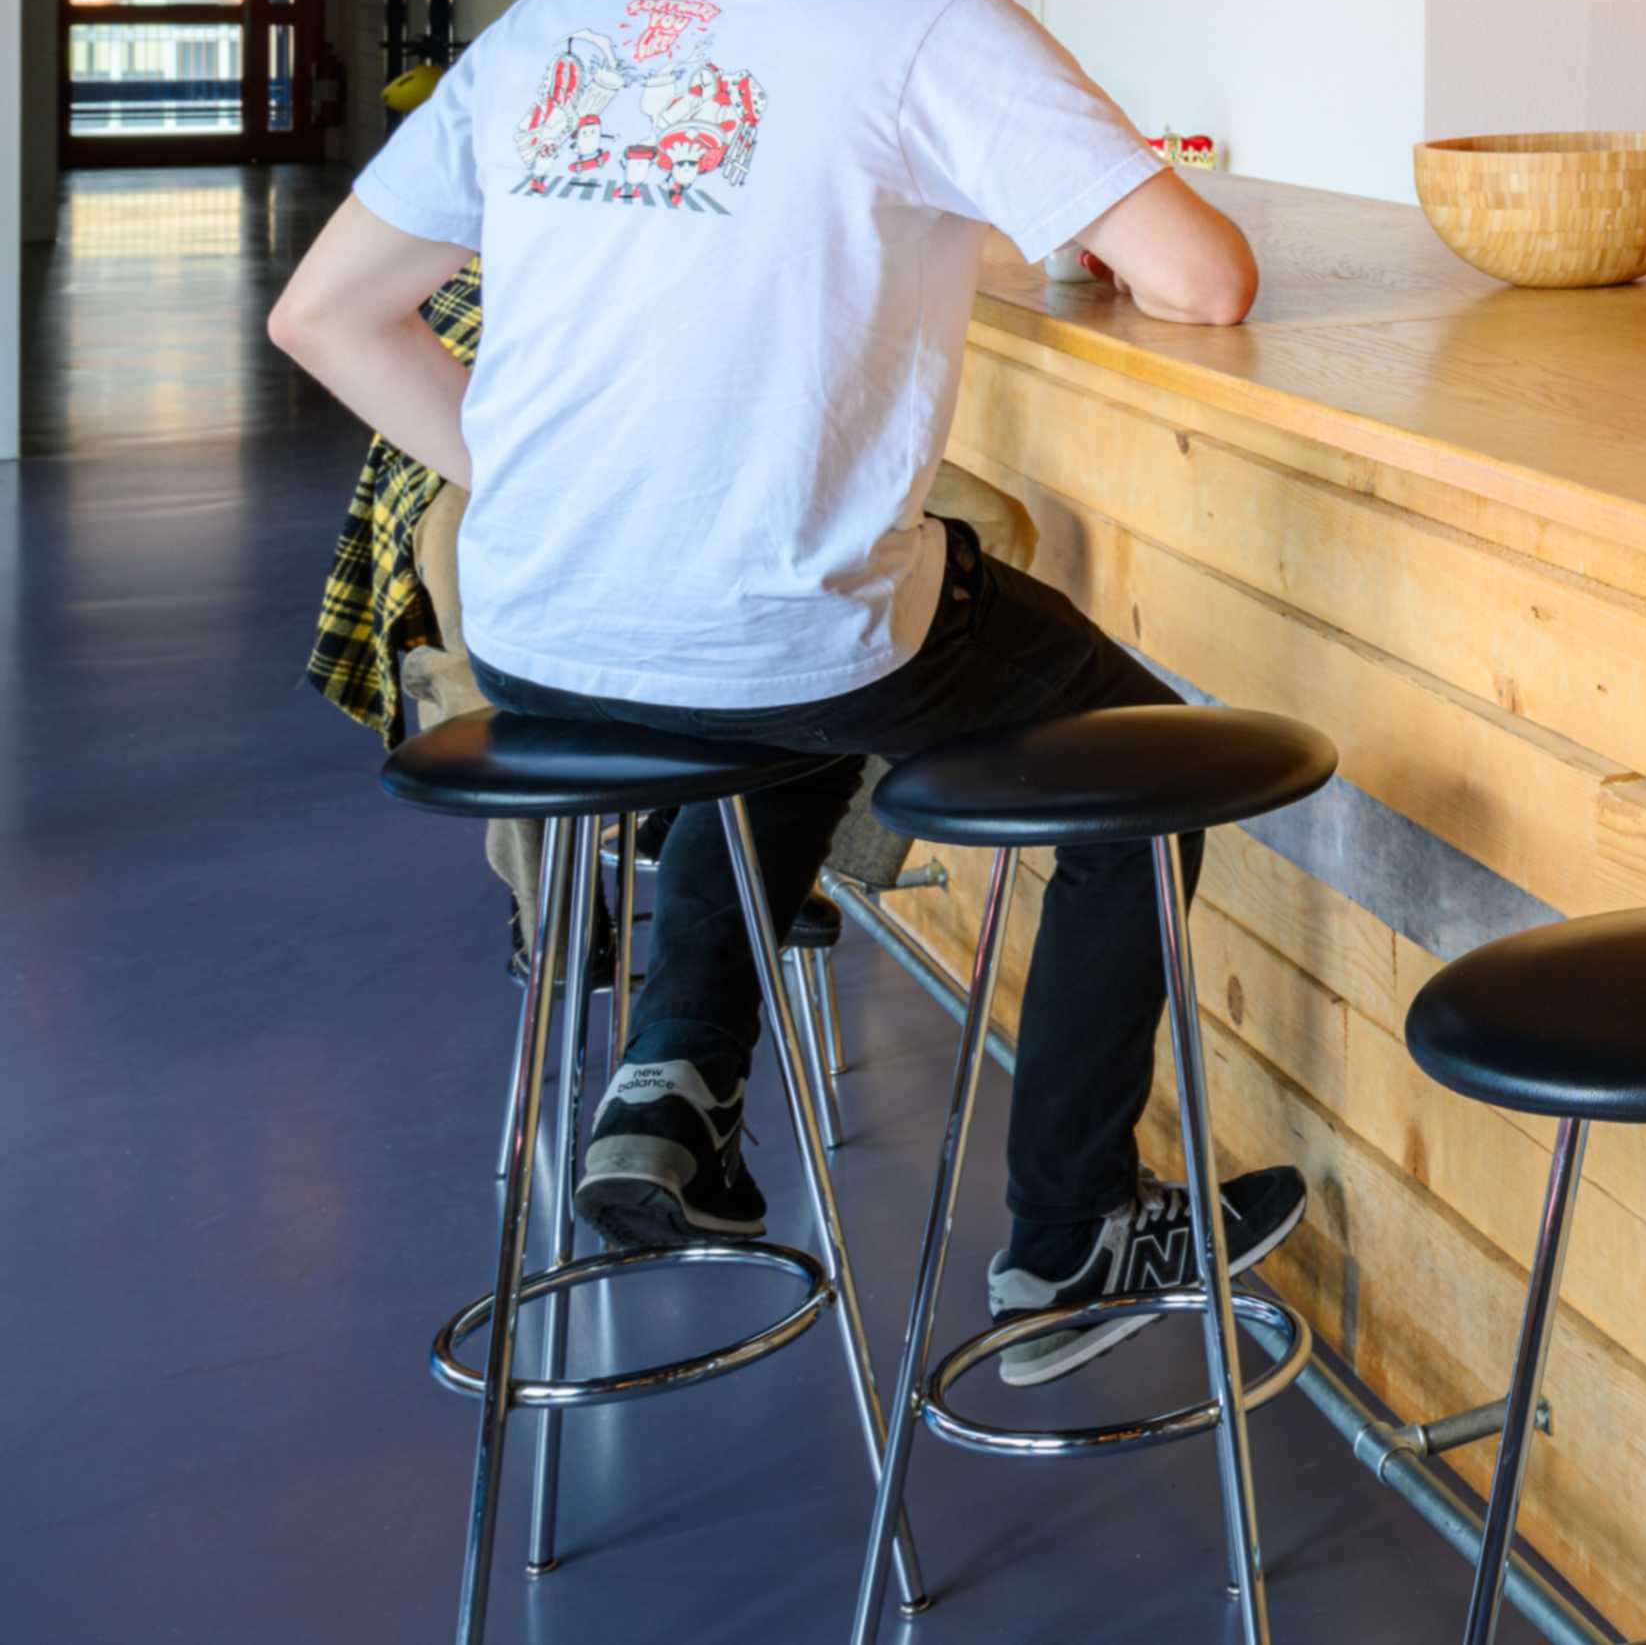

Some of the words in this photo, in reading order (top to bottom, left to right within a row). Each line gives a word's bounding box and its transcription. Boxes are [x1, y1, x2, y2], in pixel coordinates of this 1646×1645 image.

[648, 13, 692, 33] YOU
[632, 1067, 664, 1079] new
[617, 1078, 676, 1093] balance
[1122, 1226, 1190, 1292] N
